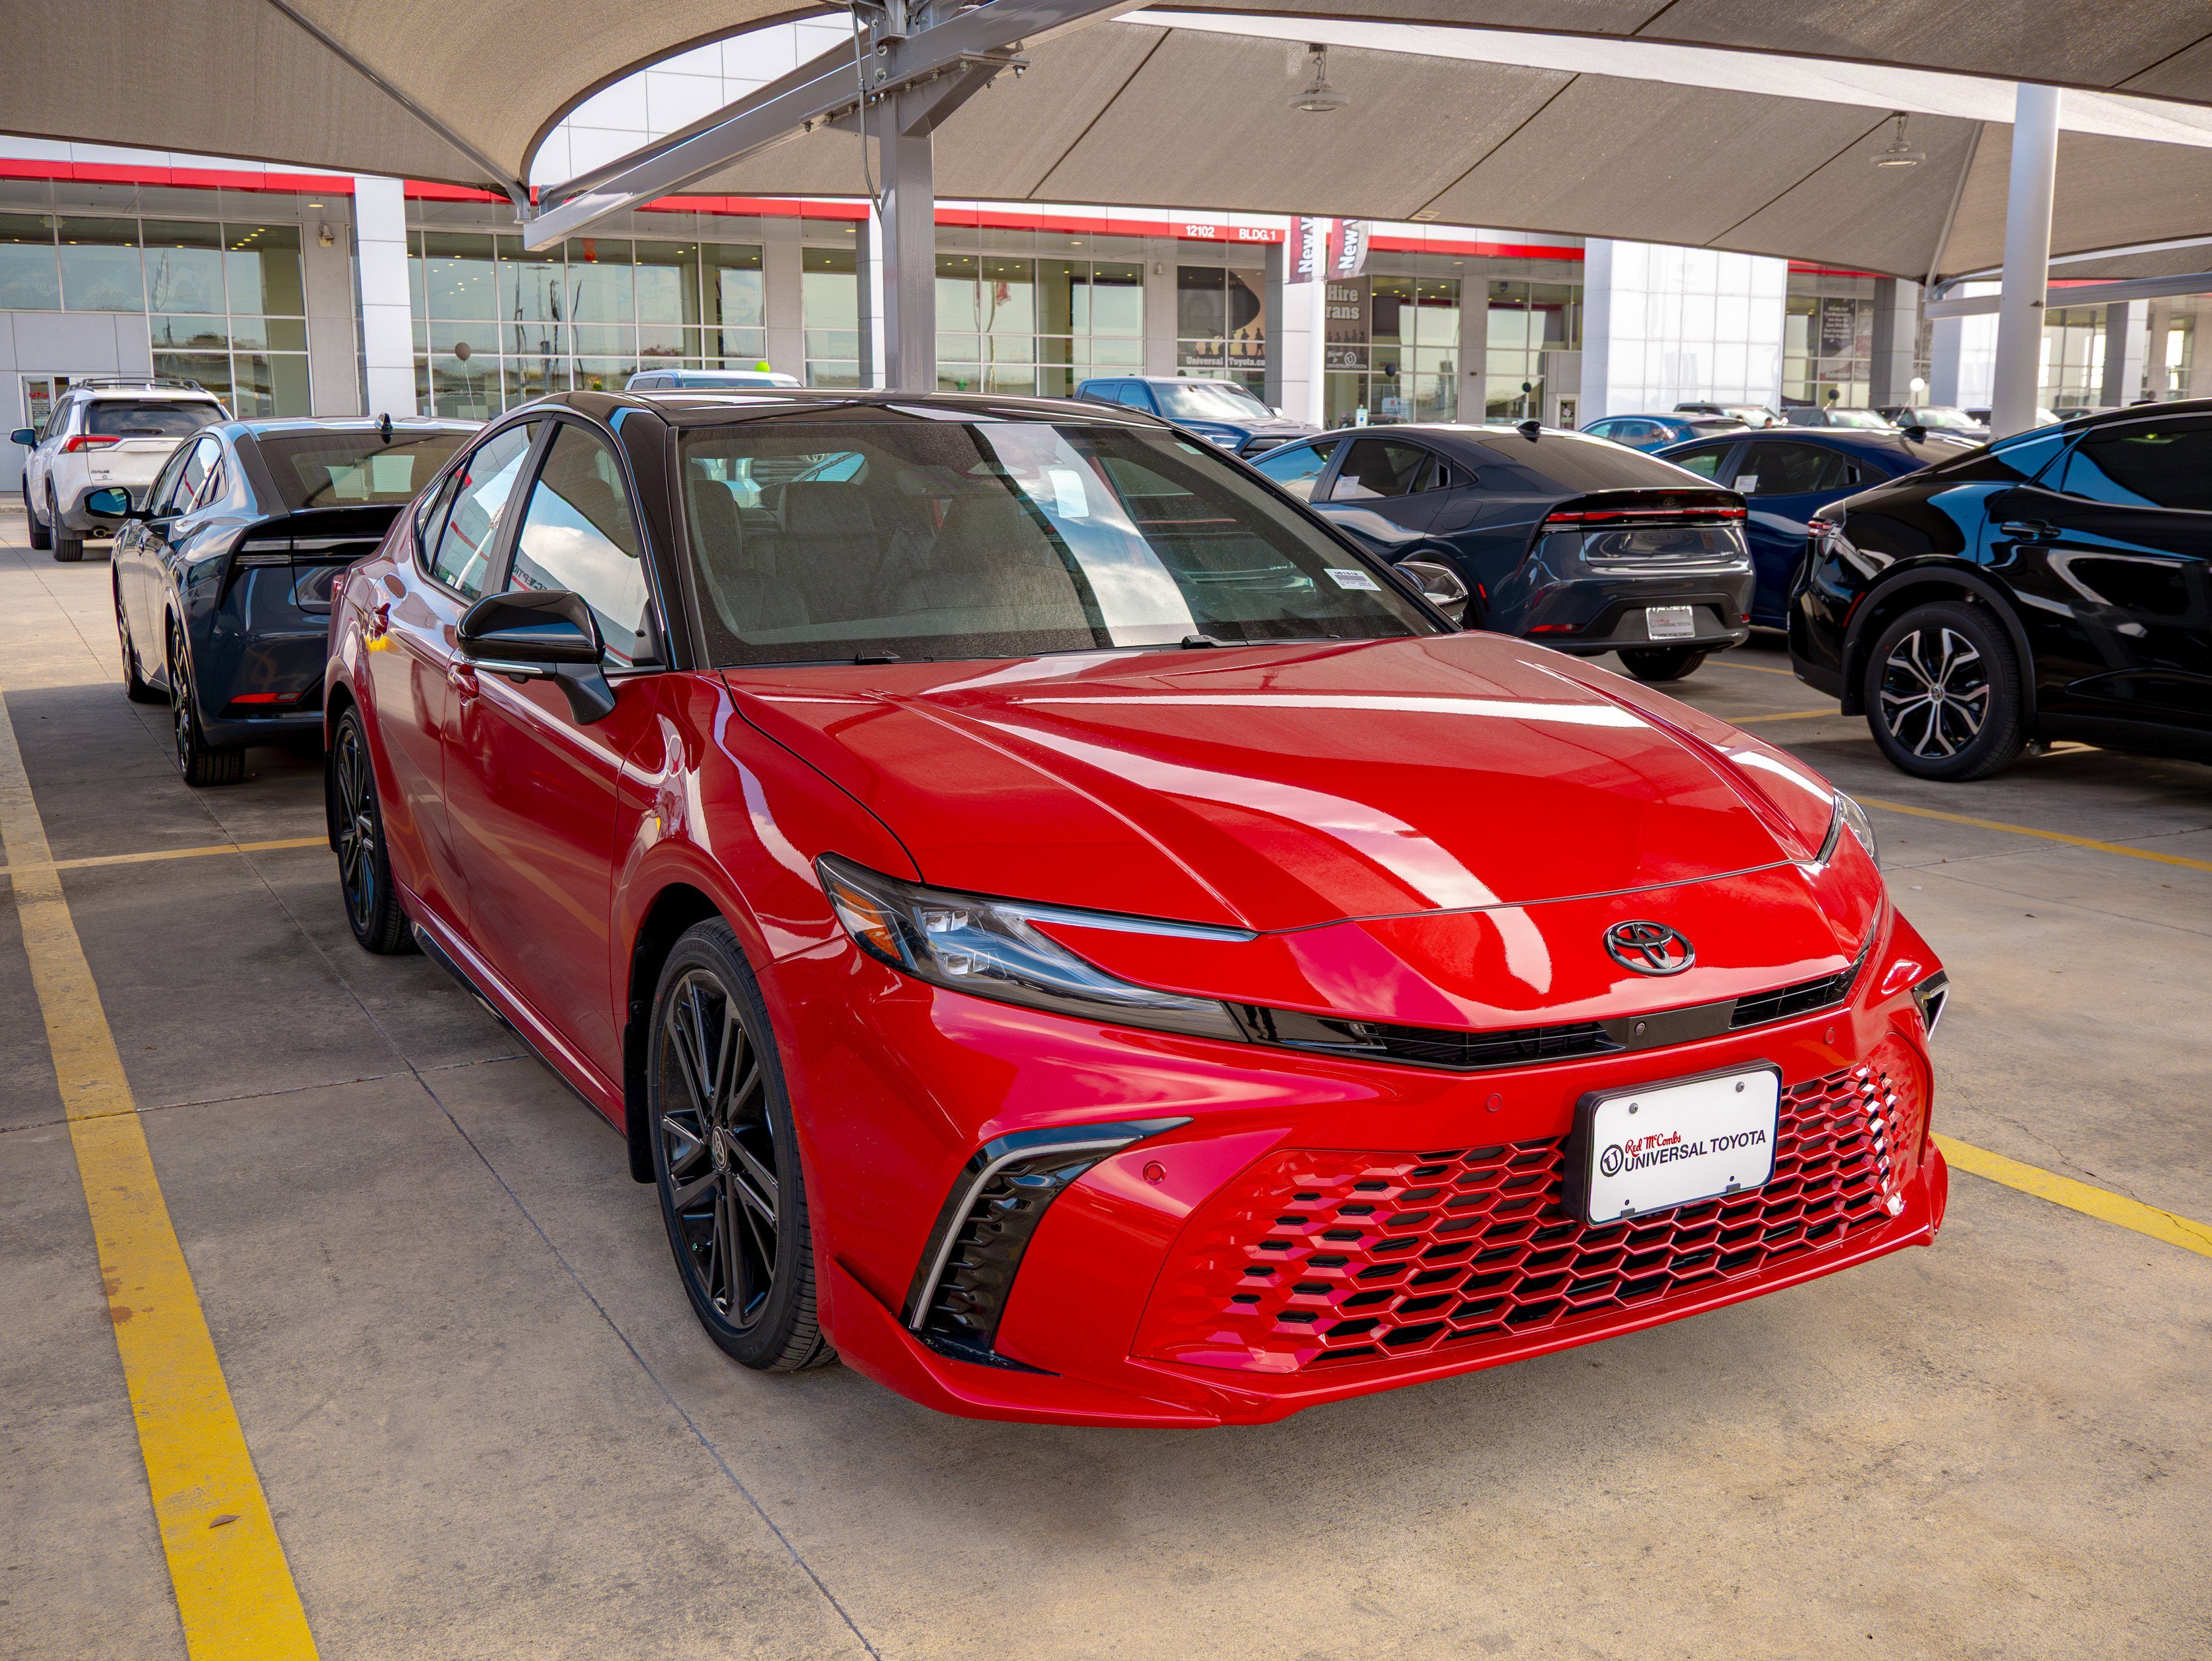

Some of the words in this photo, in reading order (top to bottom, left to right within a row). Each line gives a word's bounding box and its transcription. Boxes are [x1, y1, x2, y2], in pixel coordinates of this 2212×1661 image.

[1185, 225, 1215, 237] 12102
[1338, 229, 1359, 270] New
[1327, 285, 1359, 302] Hire
[1186, 356, 1224, 365] Universal
[1625, 1138, 1642, 1157] Red
[1644, 1131, 1681, 1149] McCombs
[1625, 1141, 1707, 1172] UNIVERSAL
[1710, 1129, 1766, 1153] TOYOTA
